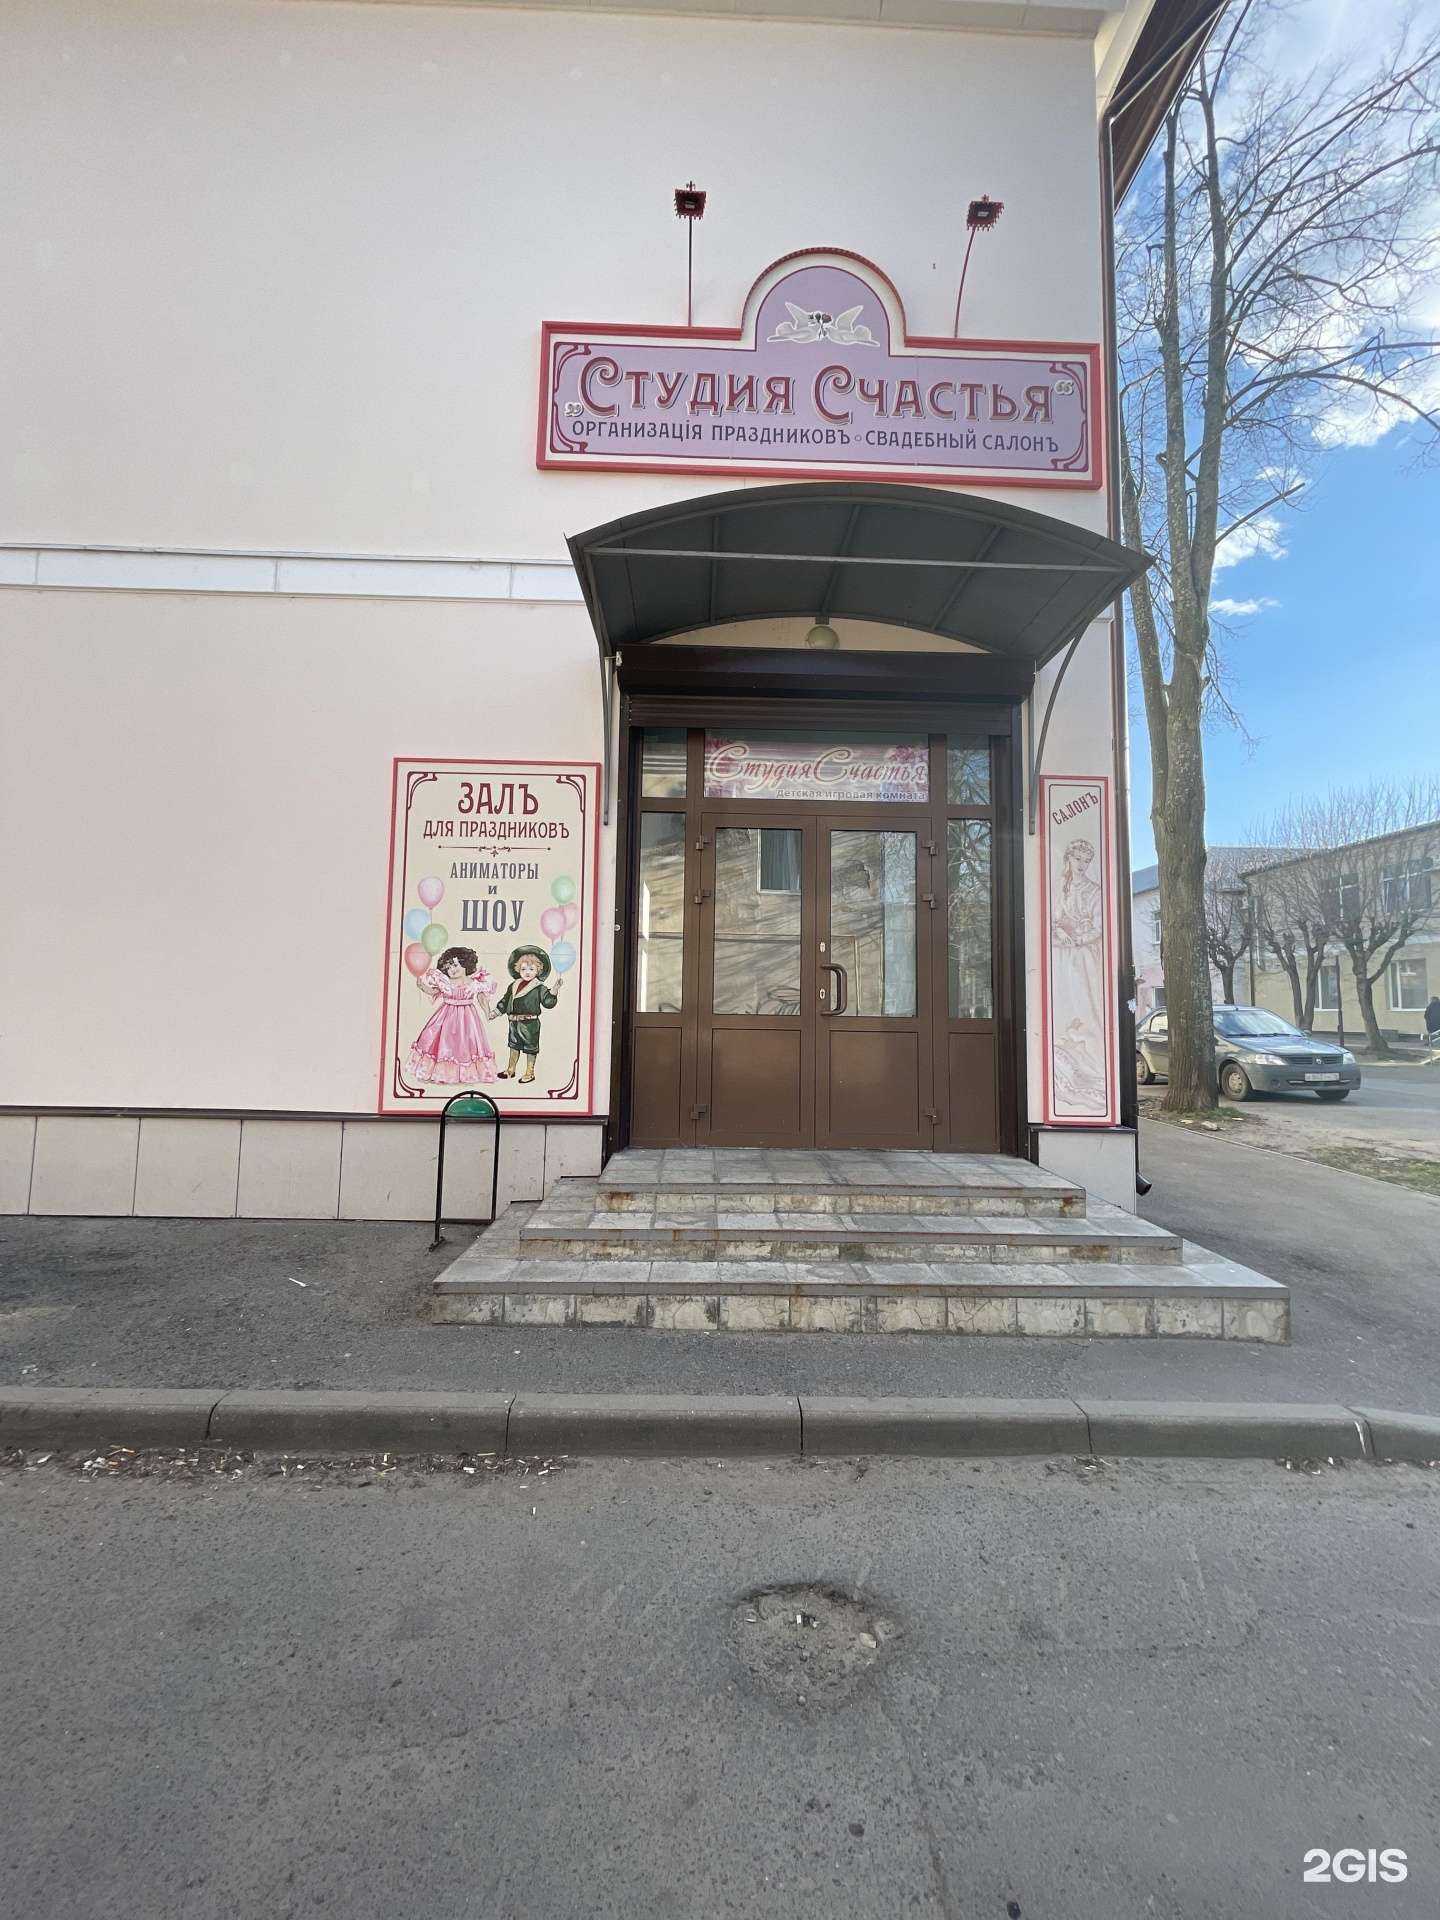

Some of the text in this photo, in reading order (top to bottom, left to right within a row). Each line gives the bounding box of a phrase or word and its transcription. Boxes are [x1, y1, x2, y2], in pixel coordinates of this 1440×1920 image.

[711, 424, 851, 446] ПРАЗДНИКОВЪ
[865, 428, 977, 450] СВАДЕБНЫЙ
[982, 434, 1060, 453] САЛОНЪ
[709, 743, 926, 792] Студия Счастья
[457, 781, 540, 816] ЗАЛЪ
[776, 788, 824, 800] Детская
[875, 790, 926, 801] комната
[1052, 791, 1099, 825] САЛОНЪ
[423, 819, 570, 841] ДЛЯ ПРАЗДНИКОВЪ
[450, 861, 539, 880] АНИМАТОРЫ
[461, 898, 525, 933] ШОУ
